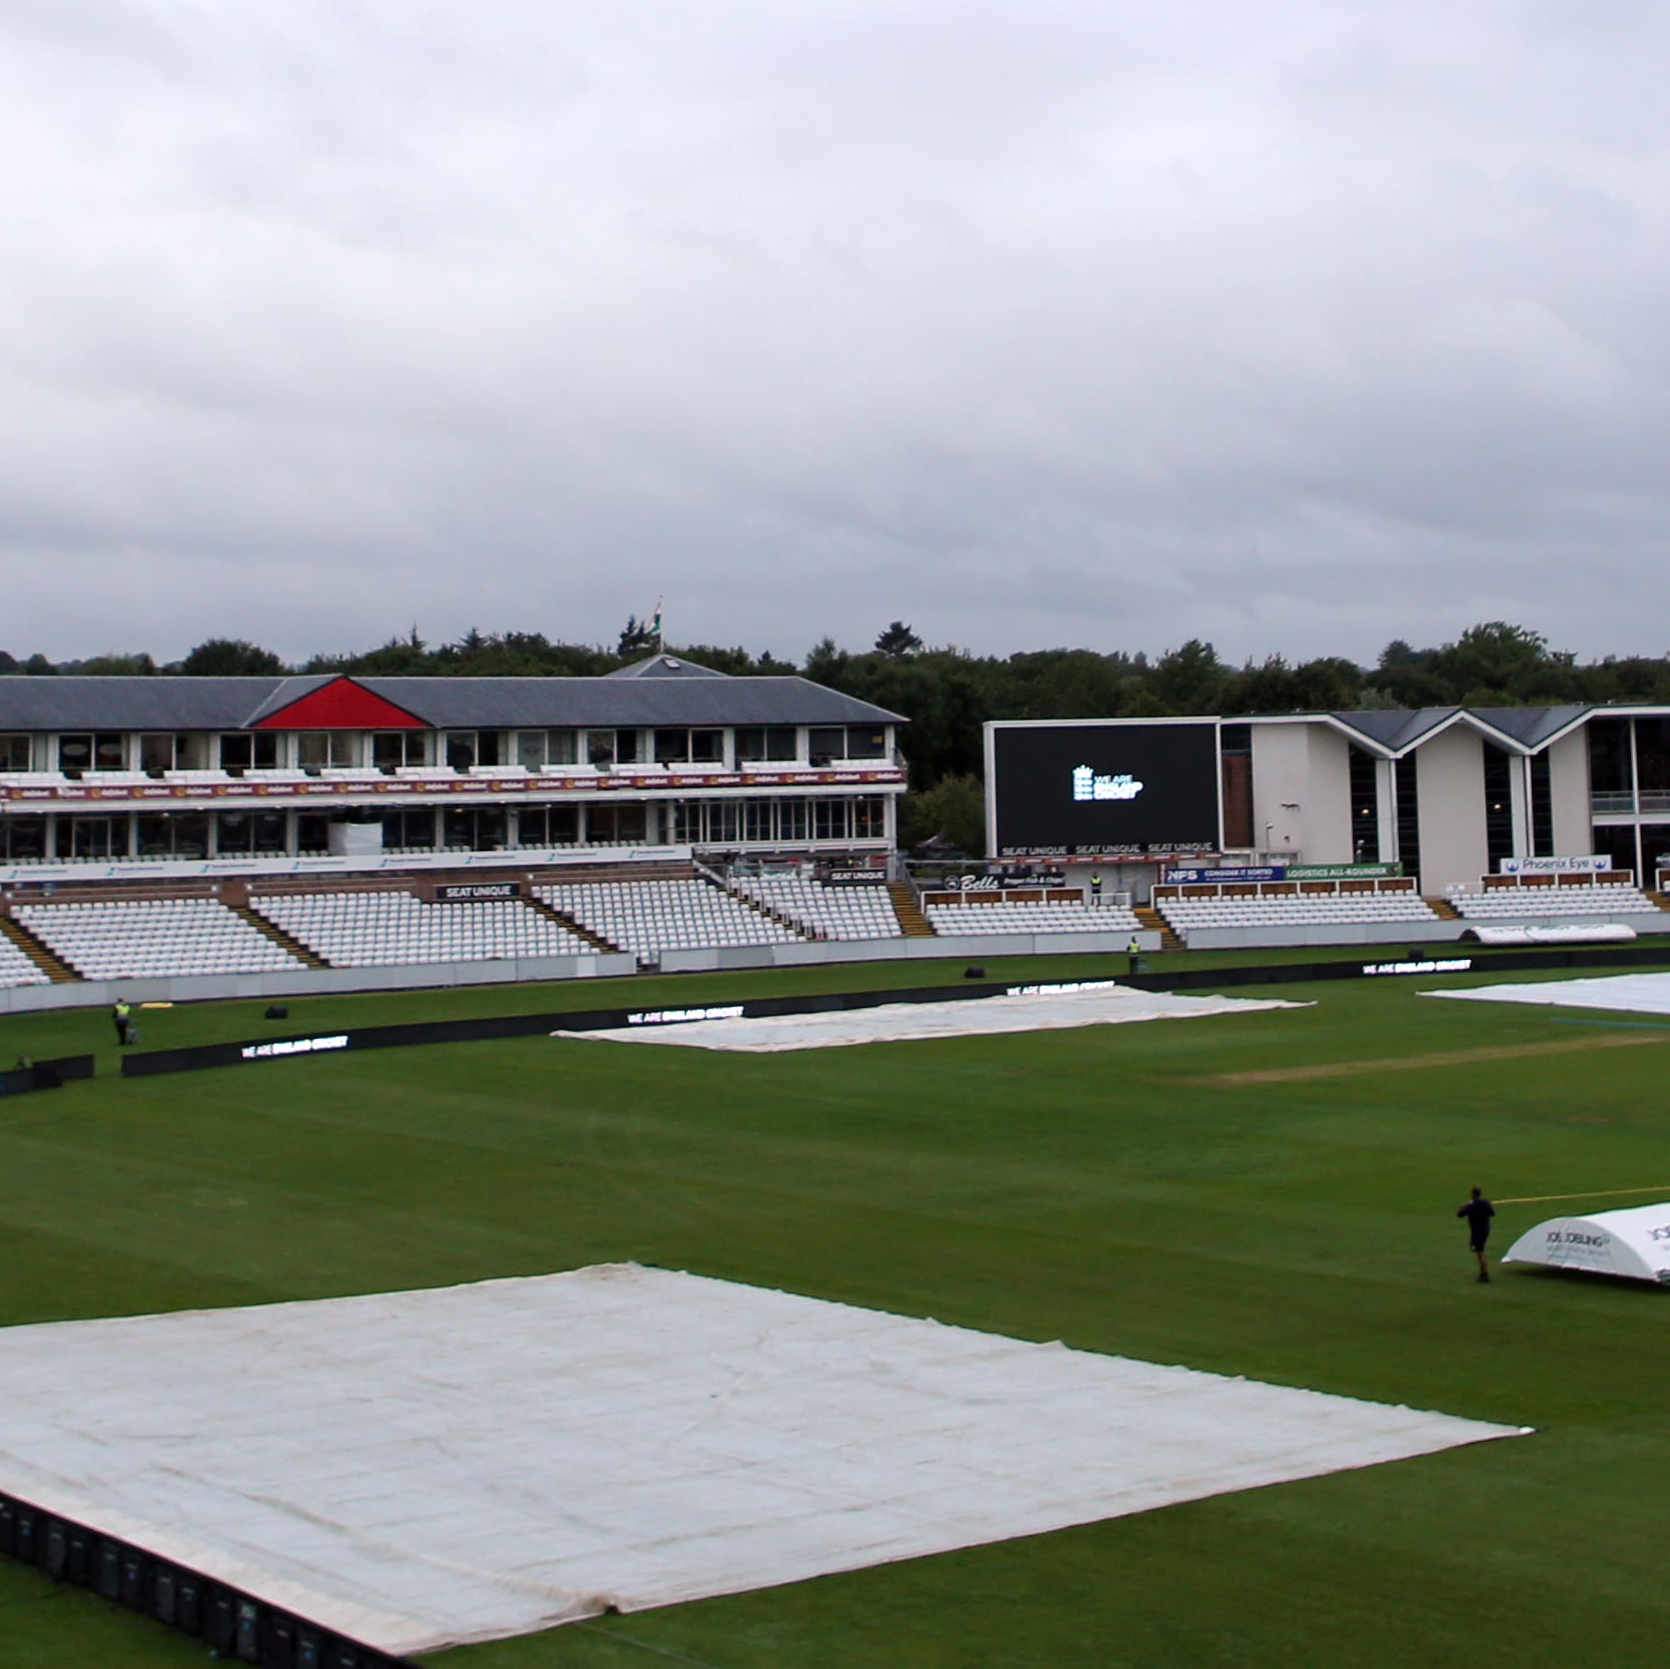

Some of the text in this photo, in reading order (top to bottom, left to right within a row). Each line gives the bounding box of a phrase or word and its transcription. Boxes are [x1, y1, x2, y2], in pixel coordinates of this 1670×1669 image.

[1002, 845, 1067, 856] SEAT UNIQUE
[1075, 844, 1140, 855] SEAT UNIQUE
[1148, 842, 1213, 852] SEAT UNIQUE
[1523, 858, 1589, 870] Phoenix Eye
[832, 871, 885, 880] SEAT UNIQUE
[1287, 867, 1387, 877] LOGISTICS ALL-ROUNDER
[960, 874, 1000, 890] Bells
[446, 885, 511, 897] SEAT UNIQUE
[1546, 1232, 1603, 1247] JOE JOBLING
